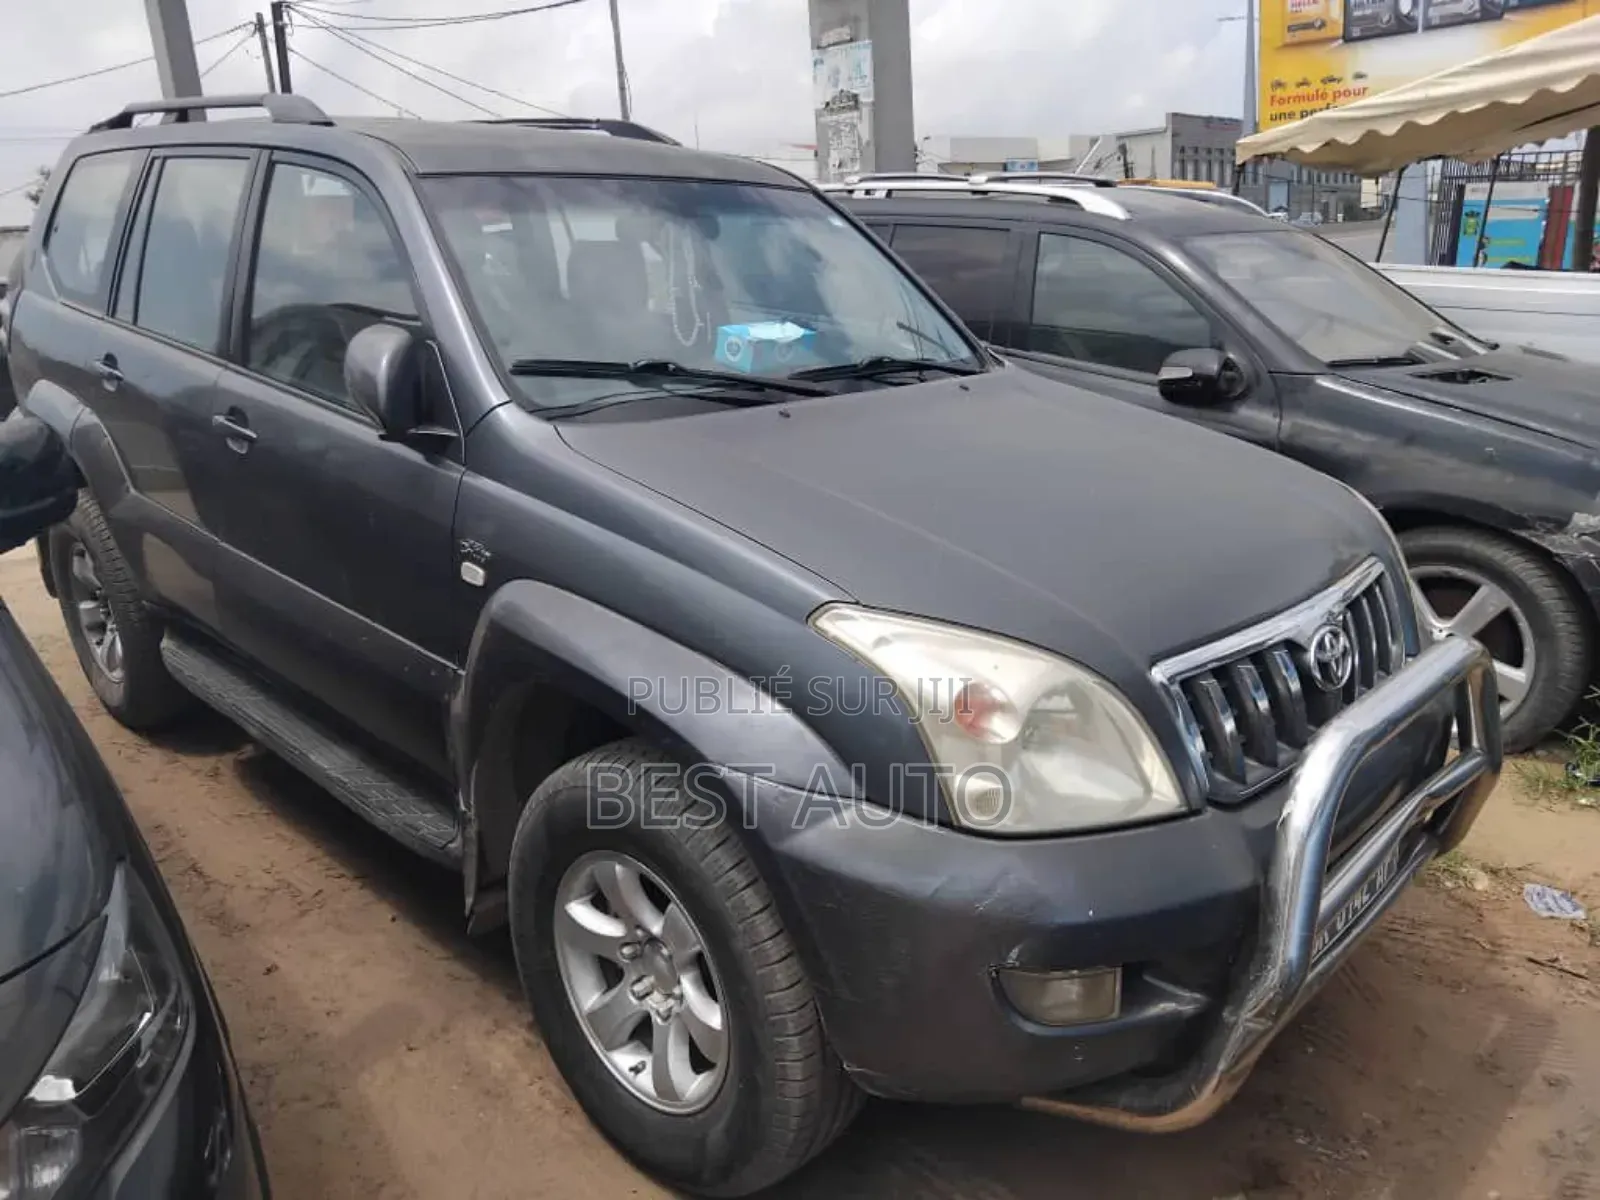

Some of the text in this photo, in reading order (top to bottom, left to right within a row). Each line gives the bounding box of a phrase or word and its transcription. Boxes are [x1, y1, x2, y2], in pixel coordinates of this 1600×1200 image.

[1269, 86, 1369, 107] Formulé pour
[1269, 110, 1296, 122] une
